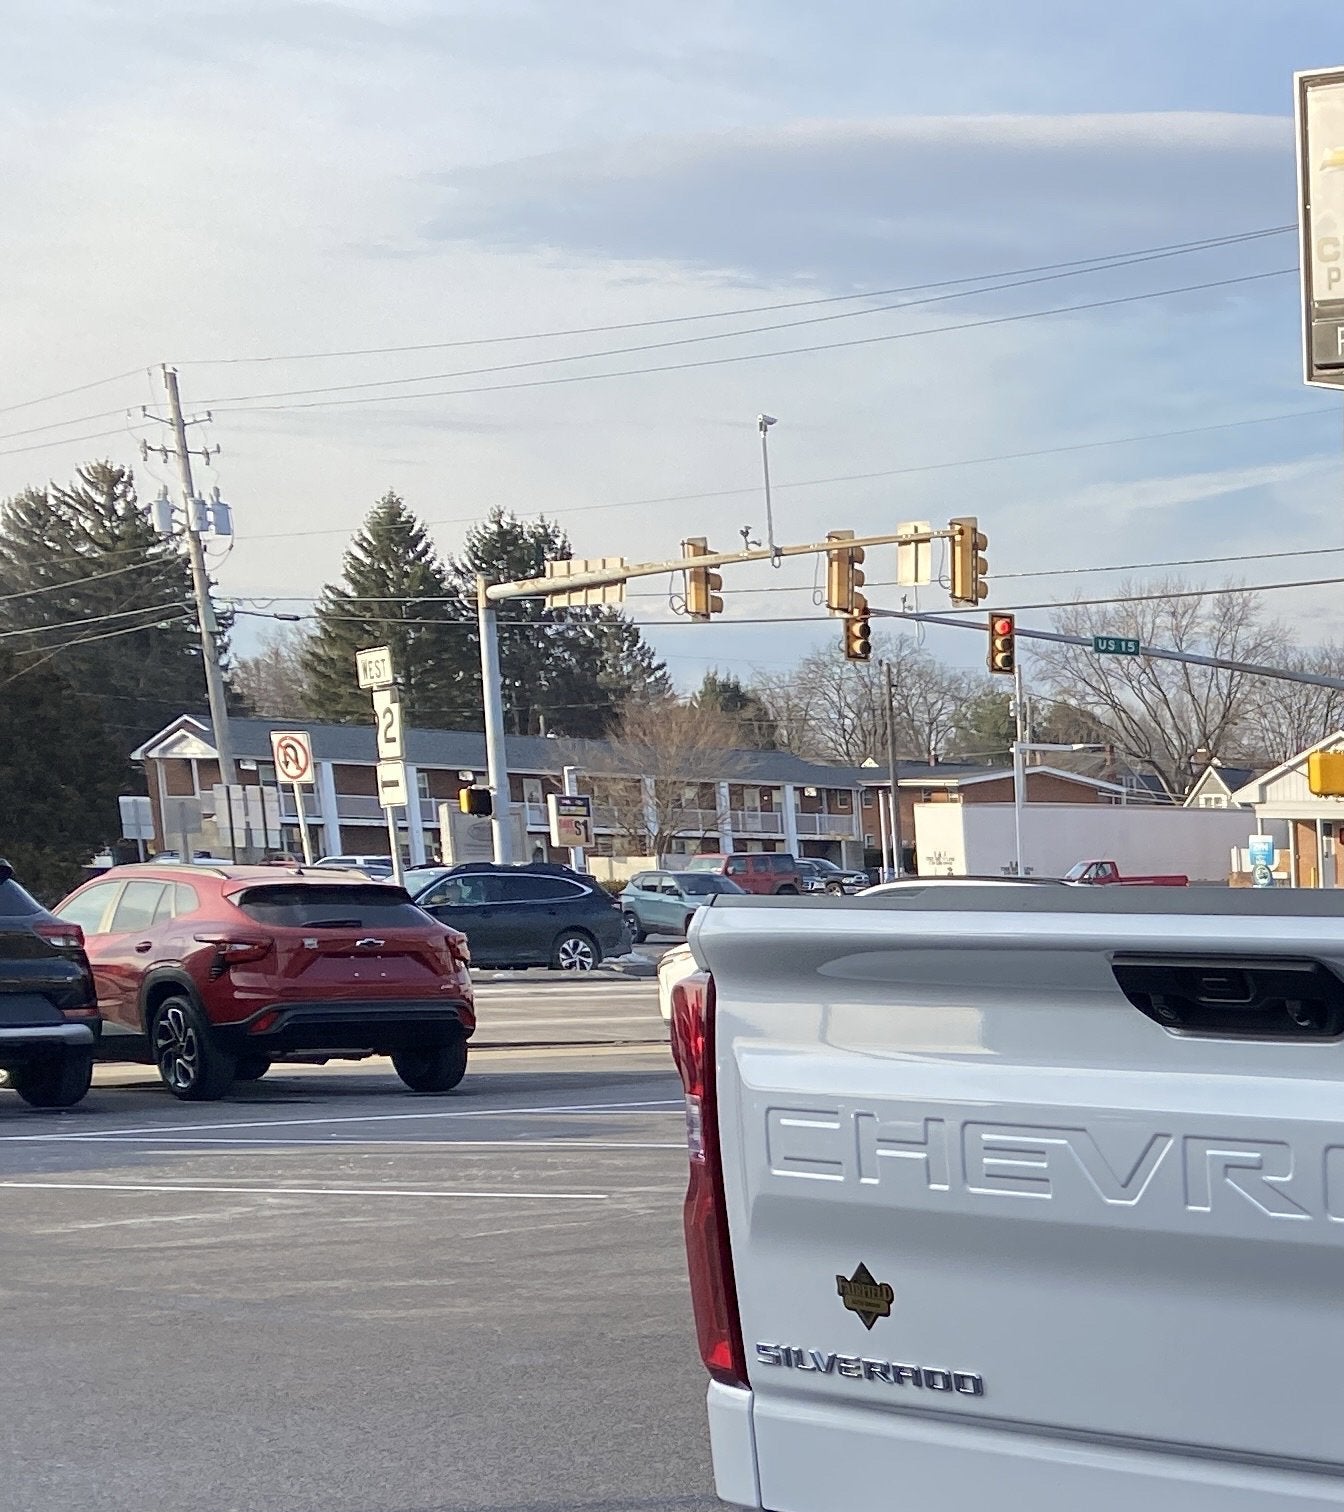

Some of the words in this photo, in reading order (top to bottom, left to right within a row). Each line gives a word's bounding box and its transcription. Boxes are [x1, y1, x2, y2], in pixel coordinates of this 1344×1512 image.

[1098, 639, 1115, 651] US
[1121, 640, 1136, 653] 15
[361, 658, 386, 681] WEST
[382, 706, 397, 744] 2
[755, 1341, 985, 1397] SILVERADO
